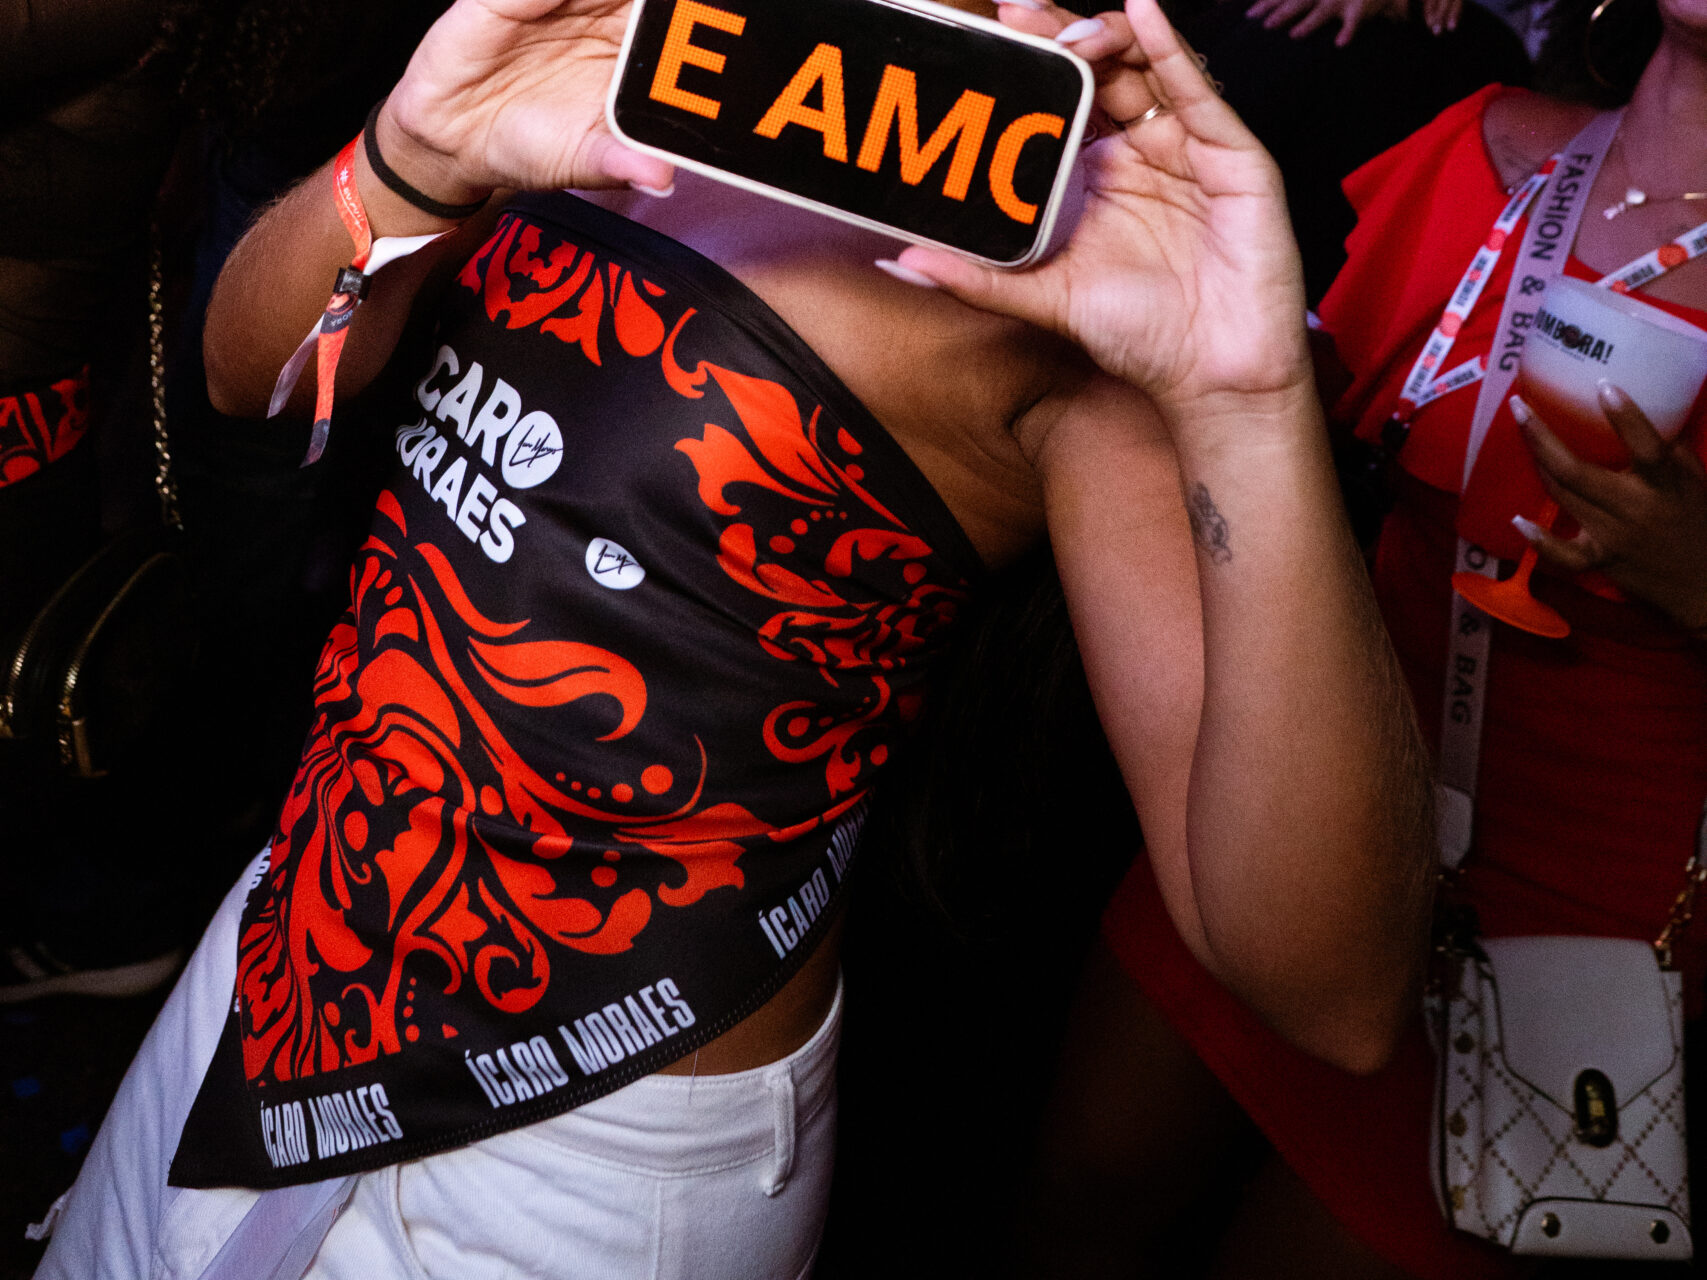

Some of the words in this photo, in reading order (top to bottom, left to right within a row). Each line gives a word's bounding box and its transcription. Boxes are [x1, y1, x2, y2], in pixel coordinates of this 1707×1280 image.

[1530, 153, 1593, 261] FASHION
[1499, 311, 1535, 372] BAG
[396, 418, 527, 564] ORAES
[758, 866, 831, 960] ÍCARO
[463, 1030, 570, 1108] ÍCARO
[558, 976, 697, 1077] MORAES
[260, 1099, 309, 1169] ÍCARO
[308, 1082, 404, 1158] MORAES
